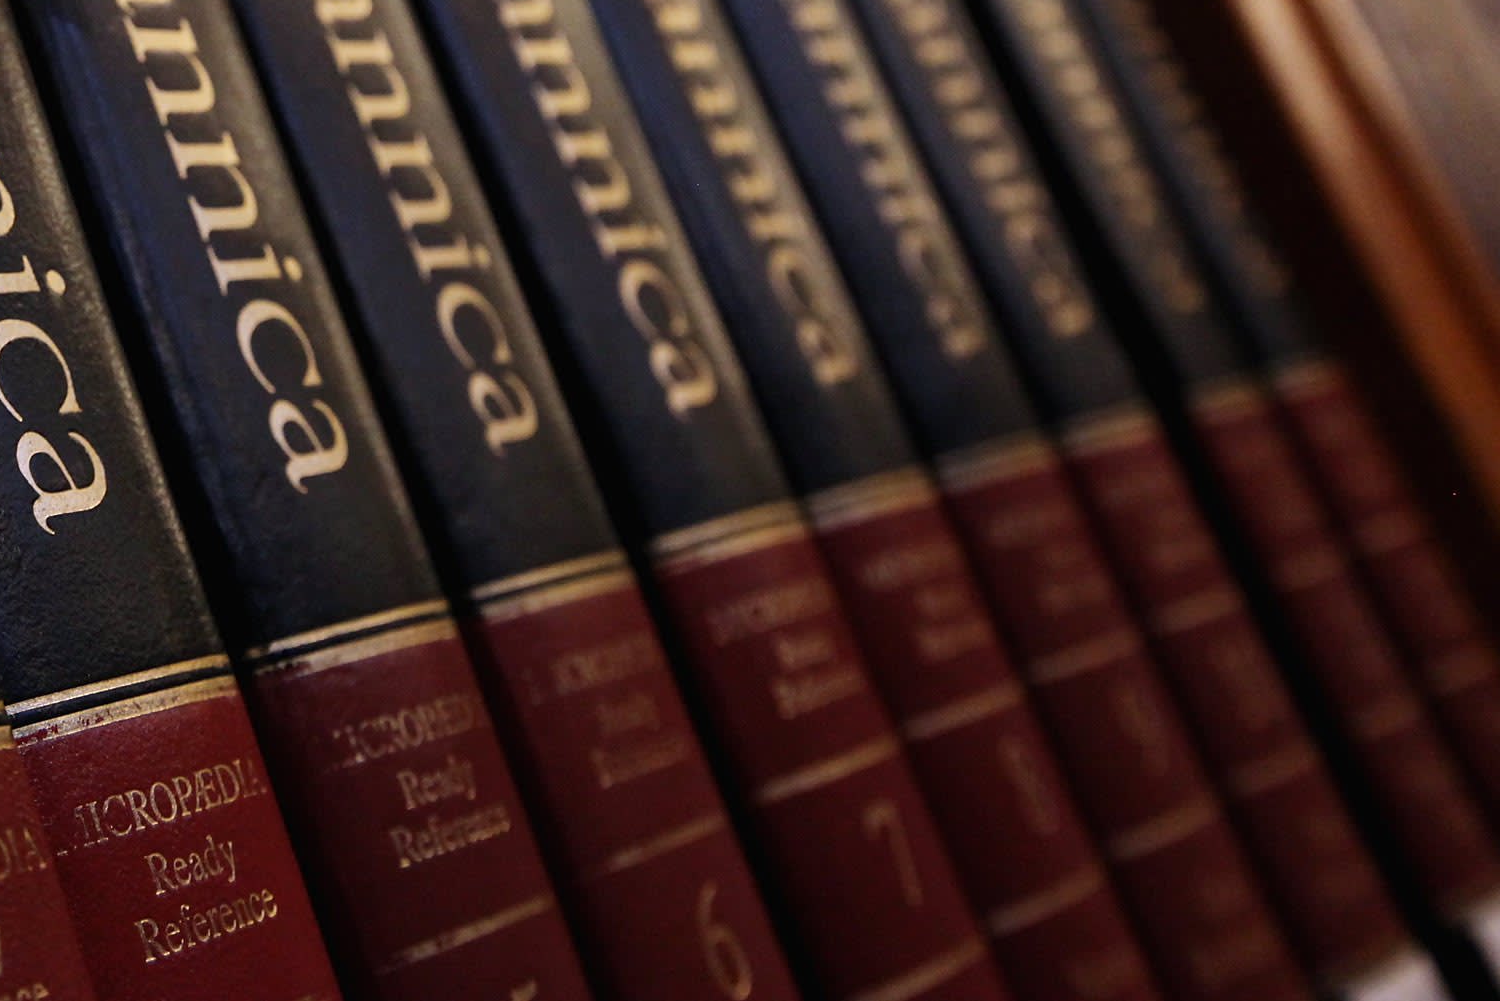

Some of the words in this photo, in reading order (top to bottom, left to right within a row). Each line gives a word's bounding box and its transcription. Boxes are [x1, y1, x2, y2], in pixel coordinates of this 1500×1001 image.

[143, 833, 237, 896] Ready
[133, 887, 279, 964] Reference
[696, 879, 753, 1000] 6
